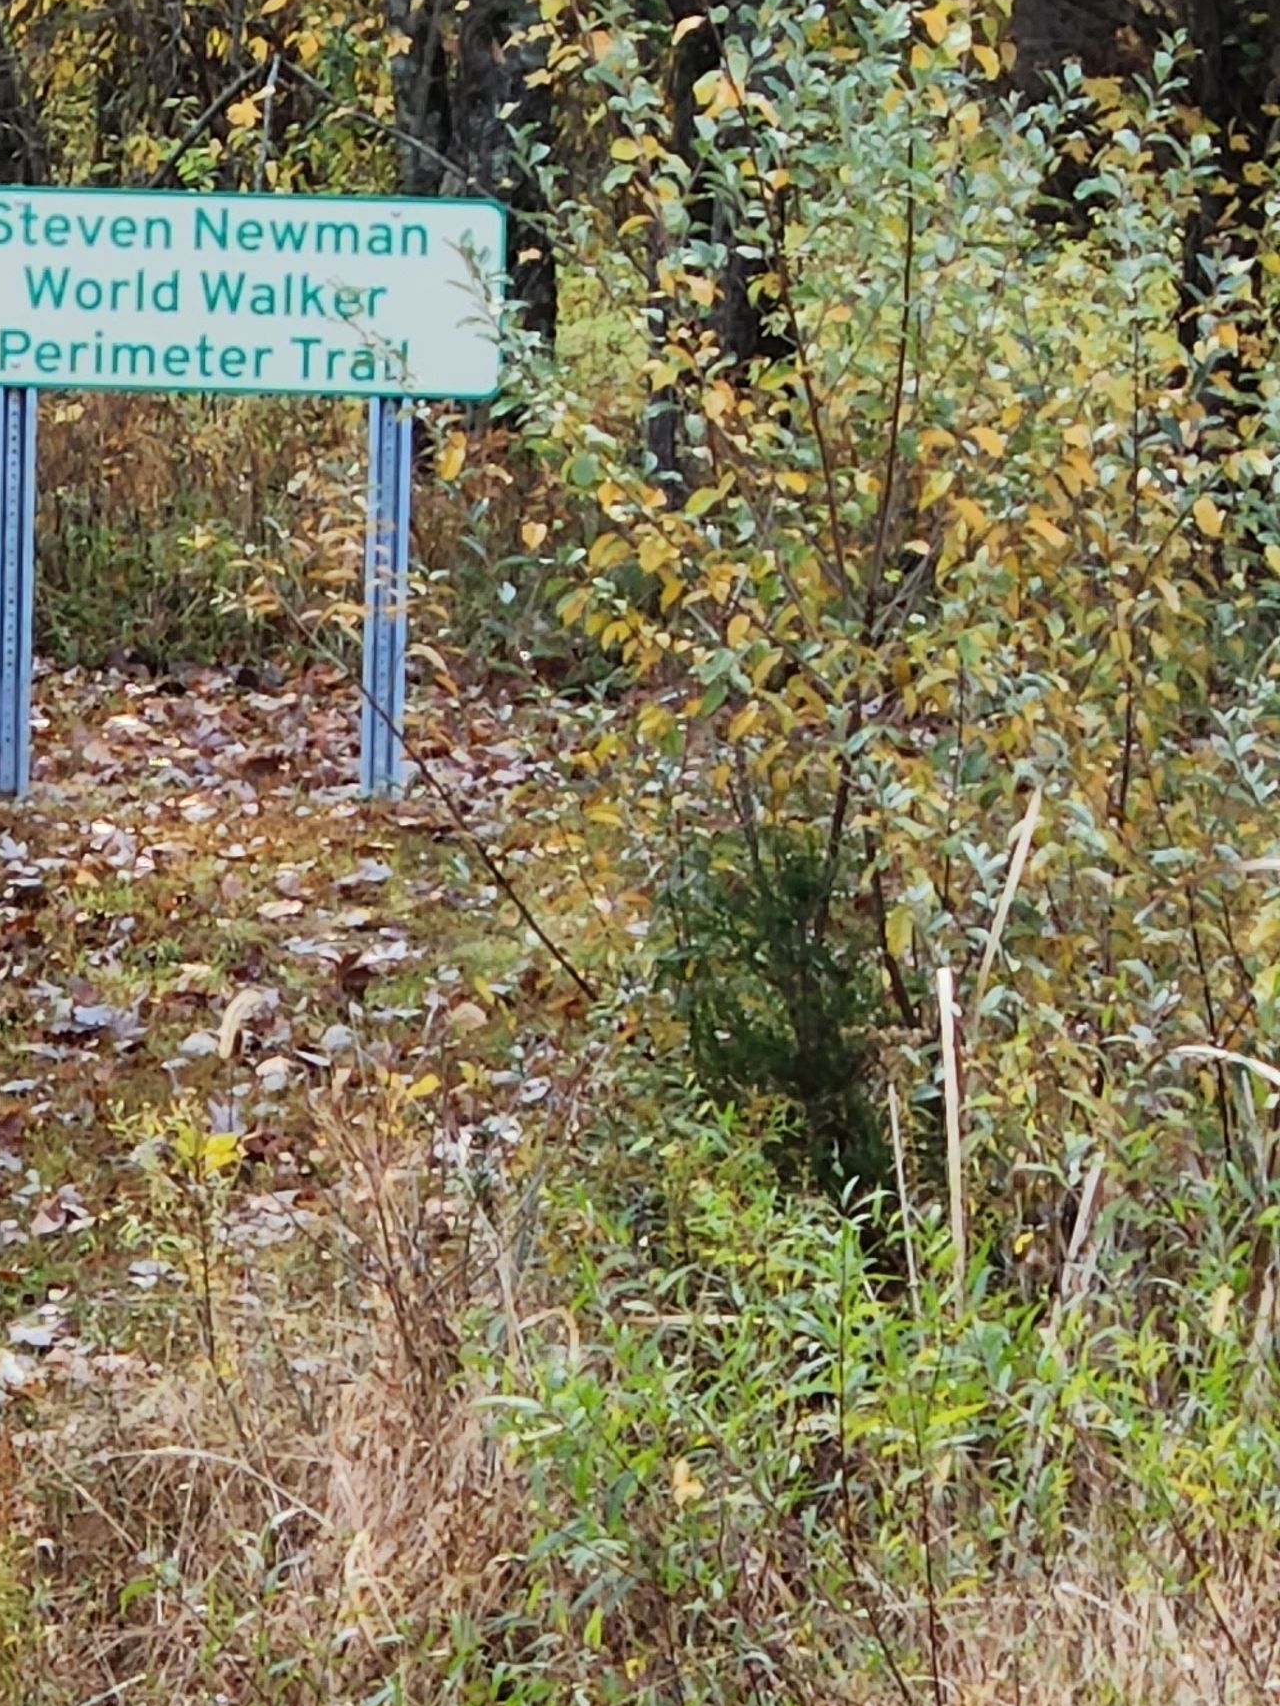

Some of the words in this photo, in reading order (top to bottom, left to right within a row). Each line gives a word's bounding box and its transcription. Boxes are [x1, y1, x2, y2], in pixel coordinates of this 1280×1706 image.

[194, 207, 429, 257] Newman
[24, 265, 179, 314] World
[201, 270, 388, 320] Walker
